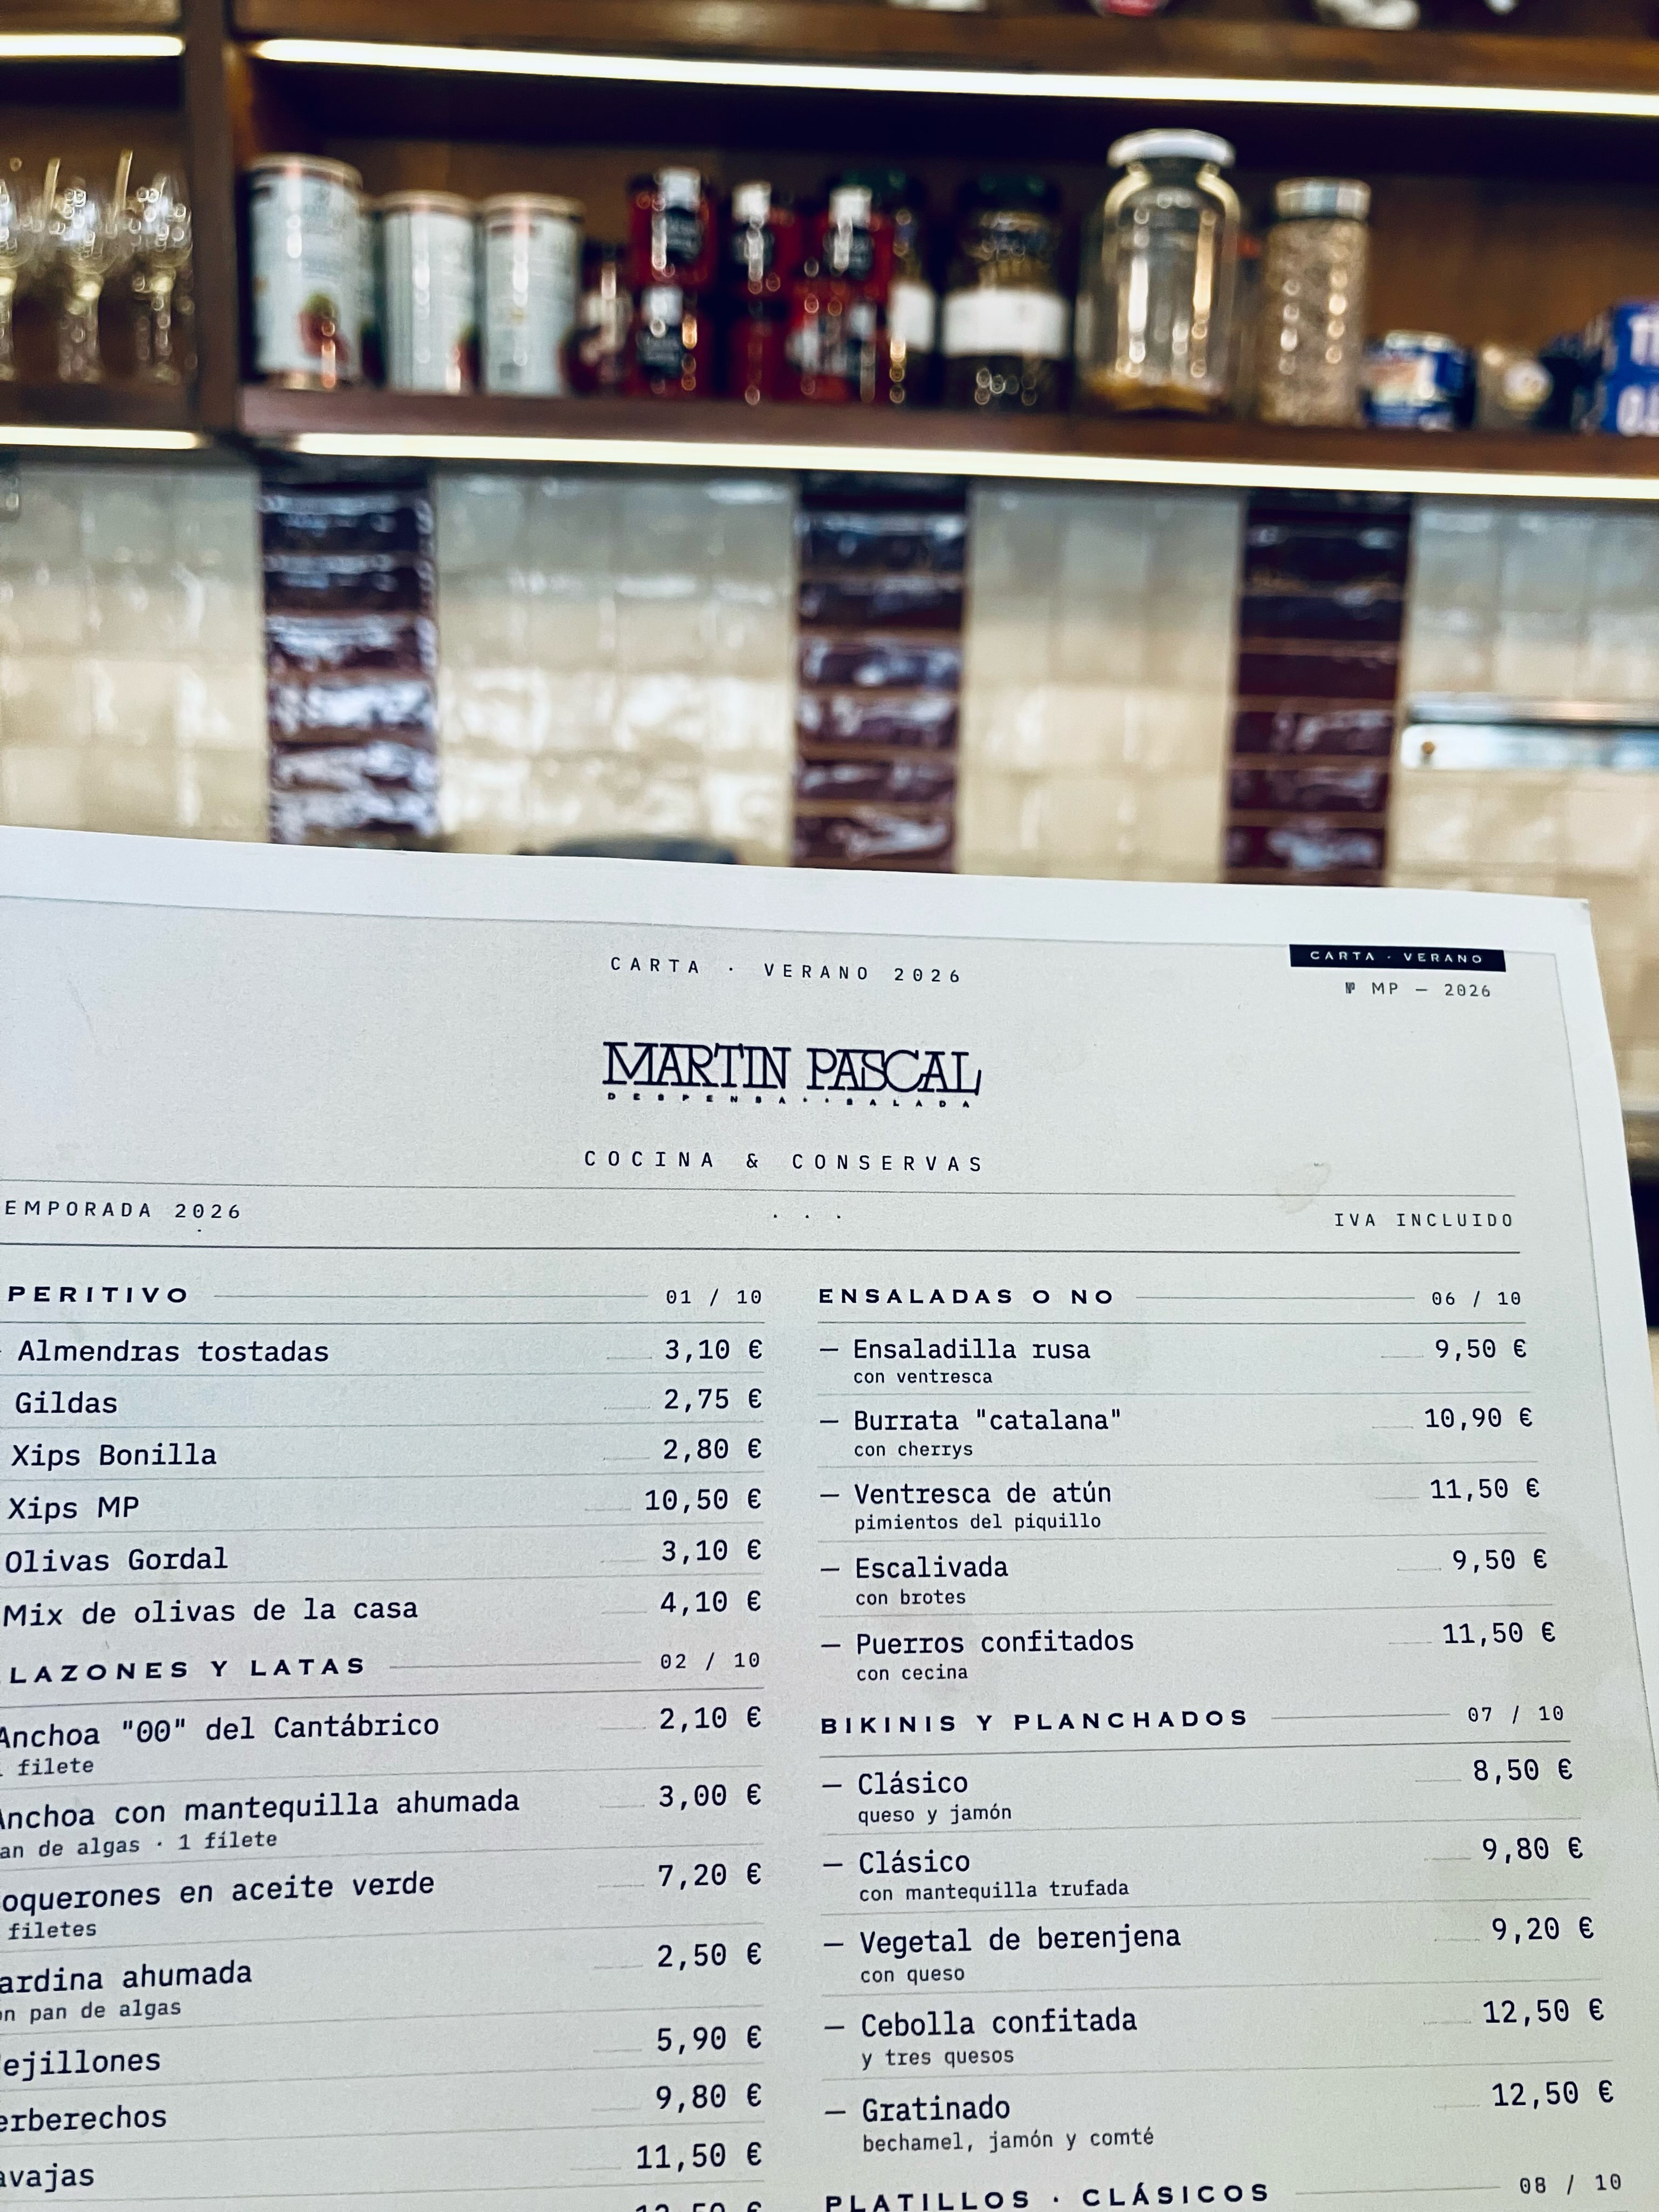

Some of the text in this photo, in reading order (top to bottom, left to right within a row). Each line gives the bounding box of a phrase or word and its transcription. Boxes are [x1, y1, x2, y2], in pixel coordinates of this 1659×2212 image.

[611, 956, 960, 983] CARTA VERANO 2026
[1310, 951, 1482, 963] CARTA VERANO
[1372, 982, 1398, 995] MP
[1444, 983, 1491, 997] 2026
[602, 1041, 982, 1097] MARTIN PASCAL
[584, 1150, 981, 1172] COCINA & CONSERVAS
[5, 1200, 240, 1219] EMPORADA 2026
[1334, 1213, 1512, 1227] IVA INCLUIDO
[8, 1285, 187, 1303] PERITIVO
[666, 1290, 761, 1304] 01 10
[819, 1288, 1112, 1304] ENSALADAS O NO
[1432, 1291, 1521, 1306] 06 10
[17, 1339, 329, 1363] Almendras tostadas
[665, 1339, 730, 1364] 3,10
[854, 1337, 1091, 1359] Ensaladilla rusa
[1435, 1339, 1496, 1362] 9,50
[854, 1368, 993, 1384] con ventresca
[15, 1391, 117, 1414] Gildas
[664, 1388, 729, 1413] 2,75
[855, 1408, 1120, 1431] Burrata "catalana"
[1424, 1407, 1502, 1431] 10,90
[11, 1442, 217, 1472] Xips Bonilla
[664, 1438, 729, 1464] 2,80
[854, 1440, 973, 1460] con cherrys
[645, 1488, 728, 1514] 10,50
[854, 1480, 1111, 1505] Ventresca de atún
[1430, 1478, 1508, 1502] 11,50
[6, 1496, 139, 1525] Xips MP
[855, 1512, 1101, 1534] pimientos del piquillo
[5, 1546, 228, 1574] Olivas Gordal
[662, 1539, 728, 1565] 3,10
[1453, 1549, 1515, 1574] 9,50
[856, 1555, 1009, 1579] Escalivada
[660, 1590, 727, 1617] 4,10
[855, 1588, 966, 1606] con brotes
[3, 1597, 419, 1627] Mix de olivas de la casa
[857, 1628, 1134, 1655] Puerros confitados
[1442, 1622, 1523, 1647] 11,50
[9, 1657, 363, 1684] LAZONES Y LATAS
[660, 1652, 760, 1670] 02 10
[857, 1663, 968, 1682] con cecina
[660, 1707, 727, 1733] 2,10
[821, 1709, 1246, 1735] BIKINIS Y PLANCHADOS
[1468, 1705, 1563, 1722] 07 10
[123, 1718, 185, 1743] "00"
[206, 1716, 255, 1741] del
[274, 1711, 439, 1739] Cantábrico
[18, 1757, 94, 1776] filete
[1473, 1758, 1539, 1785] 8,50
[858, 1770, 968, 1795] Clásico
[0, 1788, 520, 1830] nchoa con mantequilla ahumada
[659, 1784, 727, 1811] 3,00
[858, 1803, 1011, 1827] queso y jamón
[0, 1830, 277, 1859] an de algas 1 filete
[1482, 1837, 1549, 1864] 9,80
[859, 1849, 970, 1874] Clásico
[658, 1863, 727, 1891] 7,20
[2, 1870, 434, 1917] oquerones en aceite verde
[859, 1878, 1130, 1903] con mantequilla trufada
[8, 1921, 97, 1940] filetes
[860, 1923, 1182, 1959] Vegetal de berenjena
[1492, 1917, 1560, 1945] 9,20
[657, 1943, 727, 1971] 2,50
[0, 1959, 253, 1994] ardina ahumada
[860, 1968, 965, 1986] con queso
[30, 2007, 67, 2025] pan
[80, 2000, 106, 2019] de
[119, 1999, 181, 2020] algas
[861, 2006, 1138, 2038] Cebolla confitada
[1483, 1999, 1569, 2027] 12,50
[657, 2026, 726, 2055] 5,90
[3, 2049, 160, 2082] ejillones
[861, 2048, 1014, 2071] y tres quesos
[656, 2083, 726, 2114] 9,80
[862, 2093, 1010, 2123] Gratinado
[1492, 2081, 1579, 2110] 12,50
[0, 2104, 167, 2133] erberechos
[863, 2126, 1154, 2154] bechamel, jamón y comté
[637, 2142, 726, 2173] 11,50
[826, 2181, 1268, 2212] PLATILLOS CLÁSICOS
[1520, 2173, 1621, 2195] 08 10
